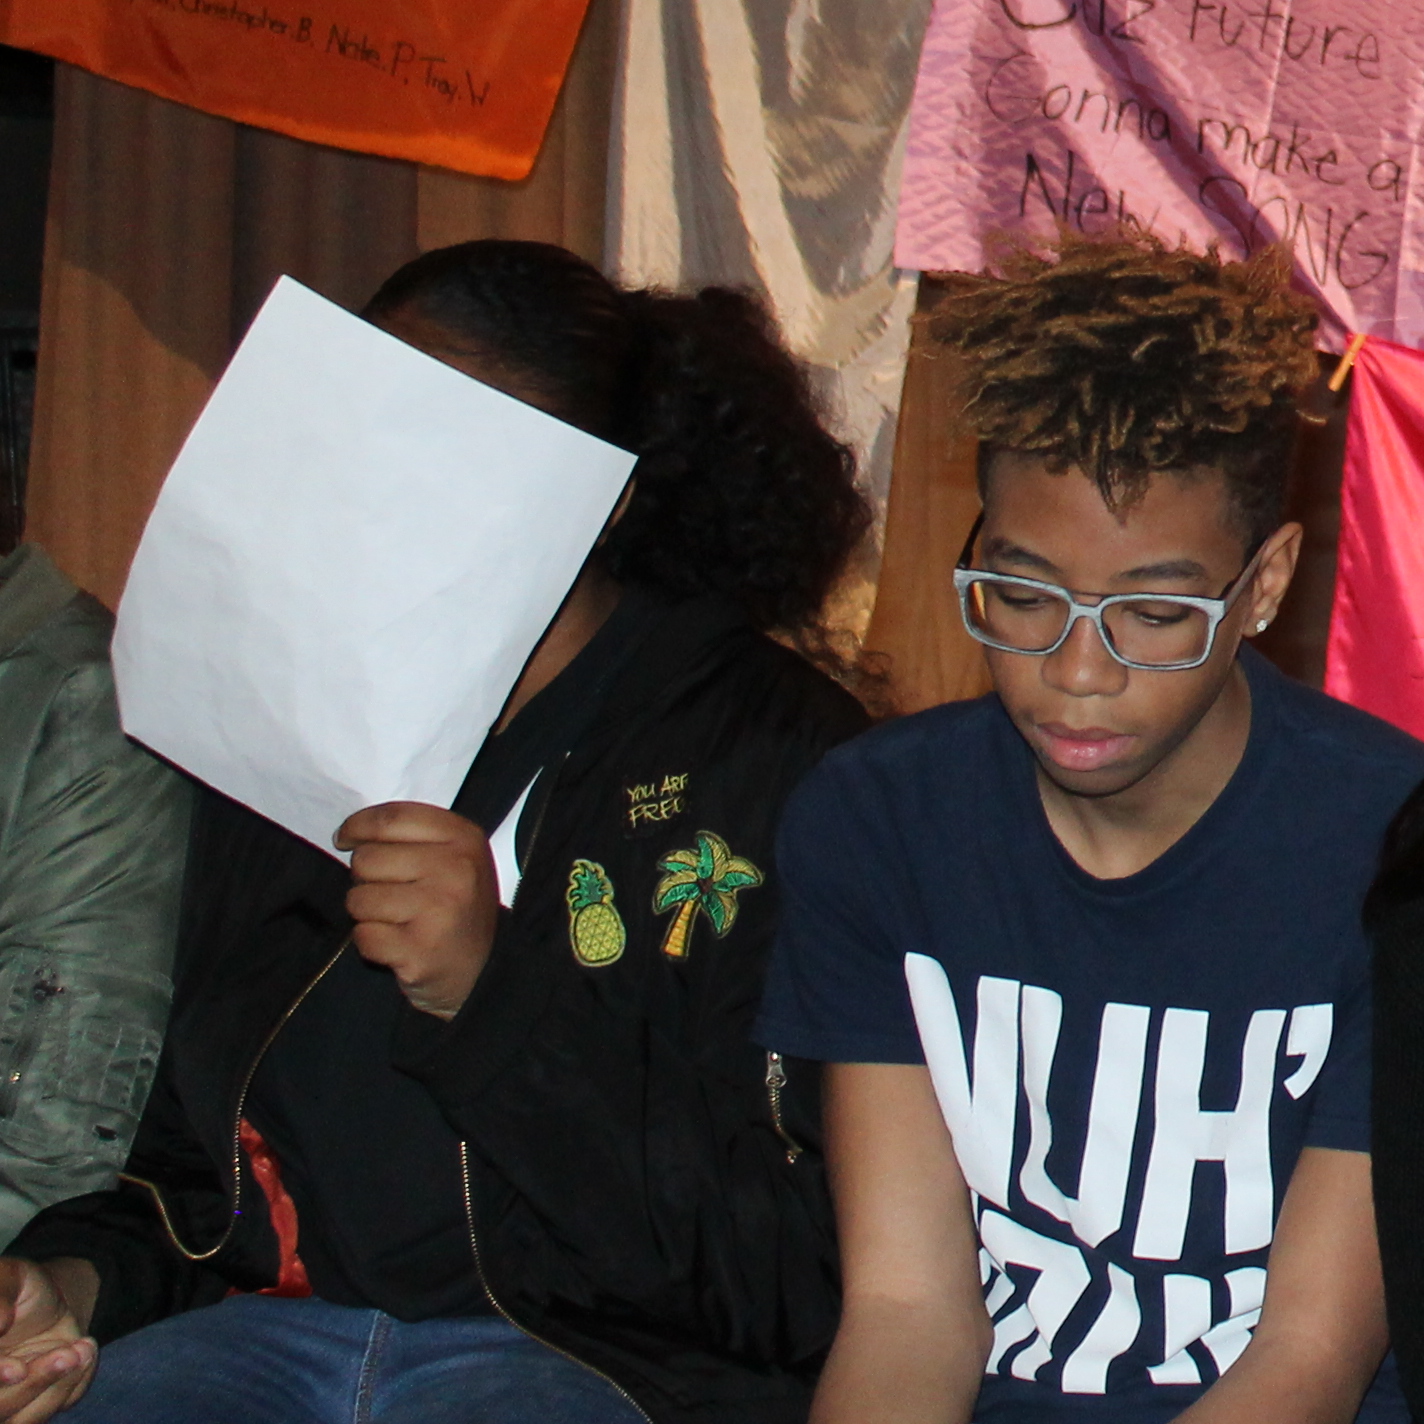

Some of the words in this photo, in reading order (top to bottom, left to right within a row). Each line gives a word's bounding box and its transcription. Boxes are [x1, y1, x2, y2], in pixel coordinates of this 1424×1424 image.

[1197, 116, 1340, 185] make
[1367, 159, 1403, 202] a
[626, 782, 657, 804] YOU
